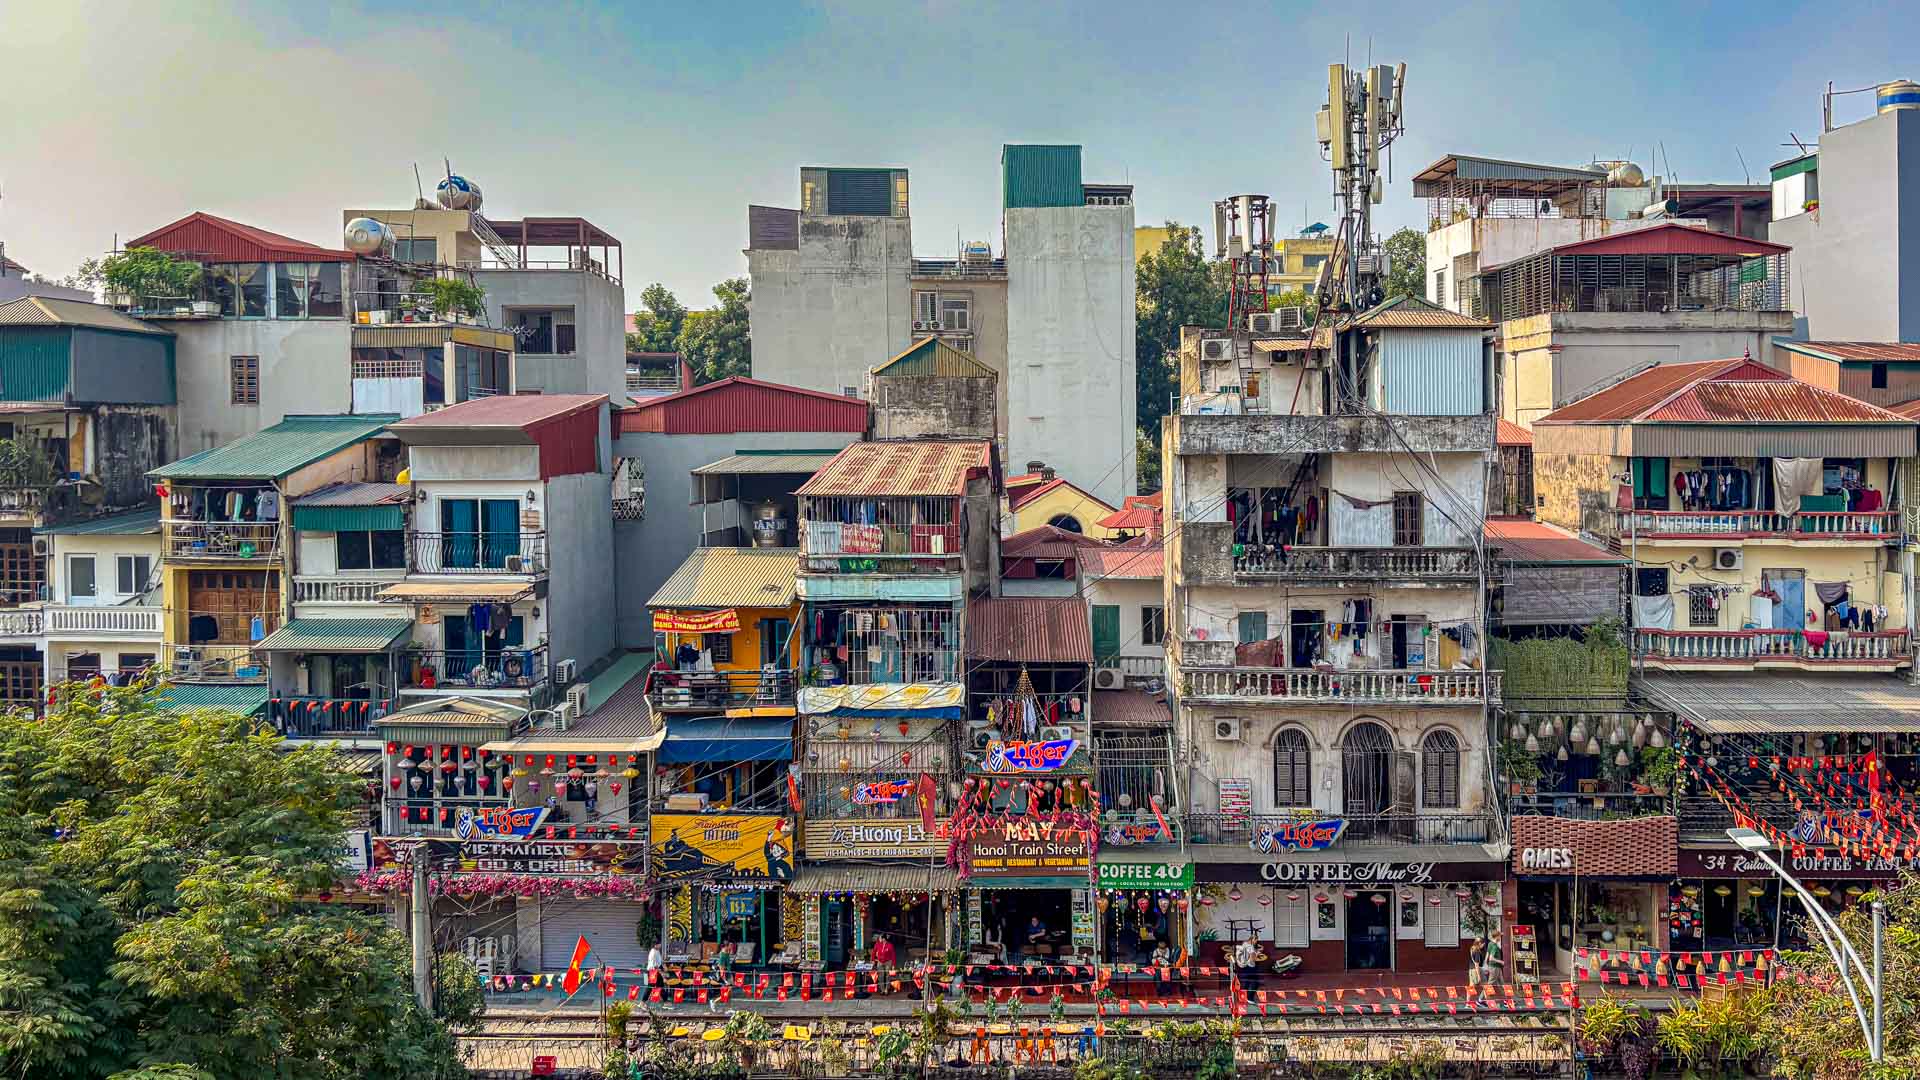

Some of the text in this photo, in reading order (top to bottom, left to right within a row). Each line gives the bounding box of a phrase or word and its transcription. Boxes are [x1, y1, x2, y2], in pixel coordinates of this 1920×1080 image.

[1009, 740, 1067, 768] Tiger
[869, 780, 909, 798] Tiger
[479, 807, 533, 834] Tiger
[1125, 825, 1159, 841] Tiger
[1280, 822, 1336, 848] Tiger
[974, 843, 1084, 856] Hanoi Train Street
[1522, 847, 1572, 868] AMES
[513, 861, 524, 871] &
[528, 859, 593, 872] DRINK
[1100, 864, 1183, 879] COFFEE 40
[1260, 862, 1352, 881] COFFEE
[1792, 856, 1851, 871] COFFEE
